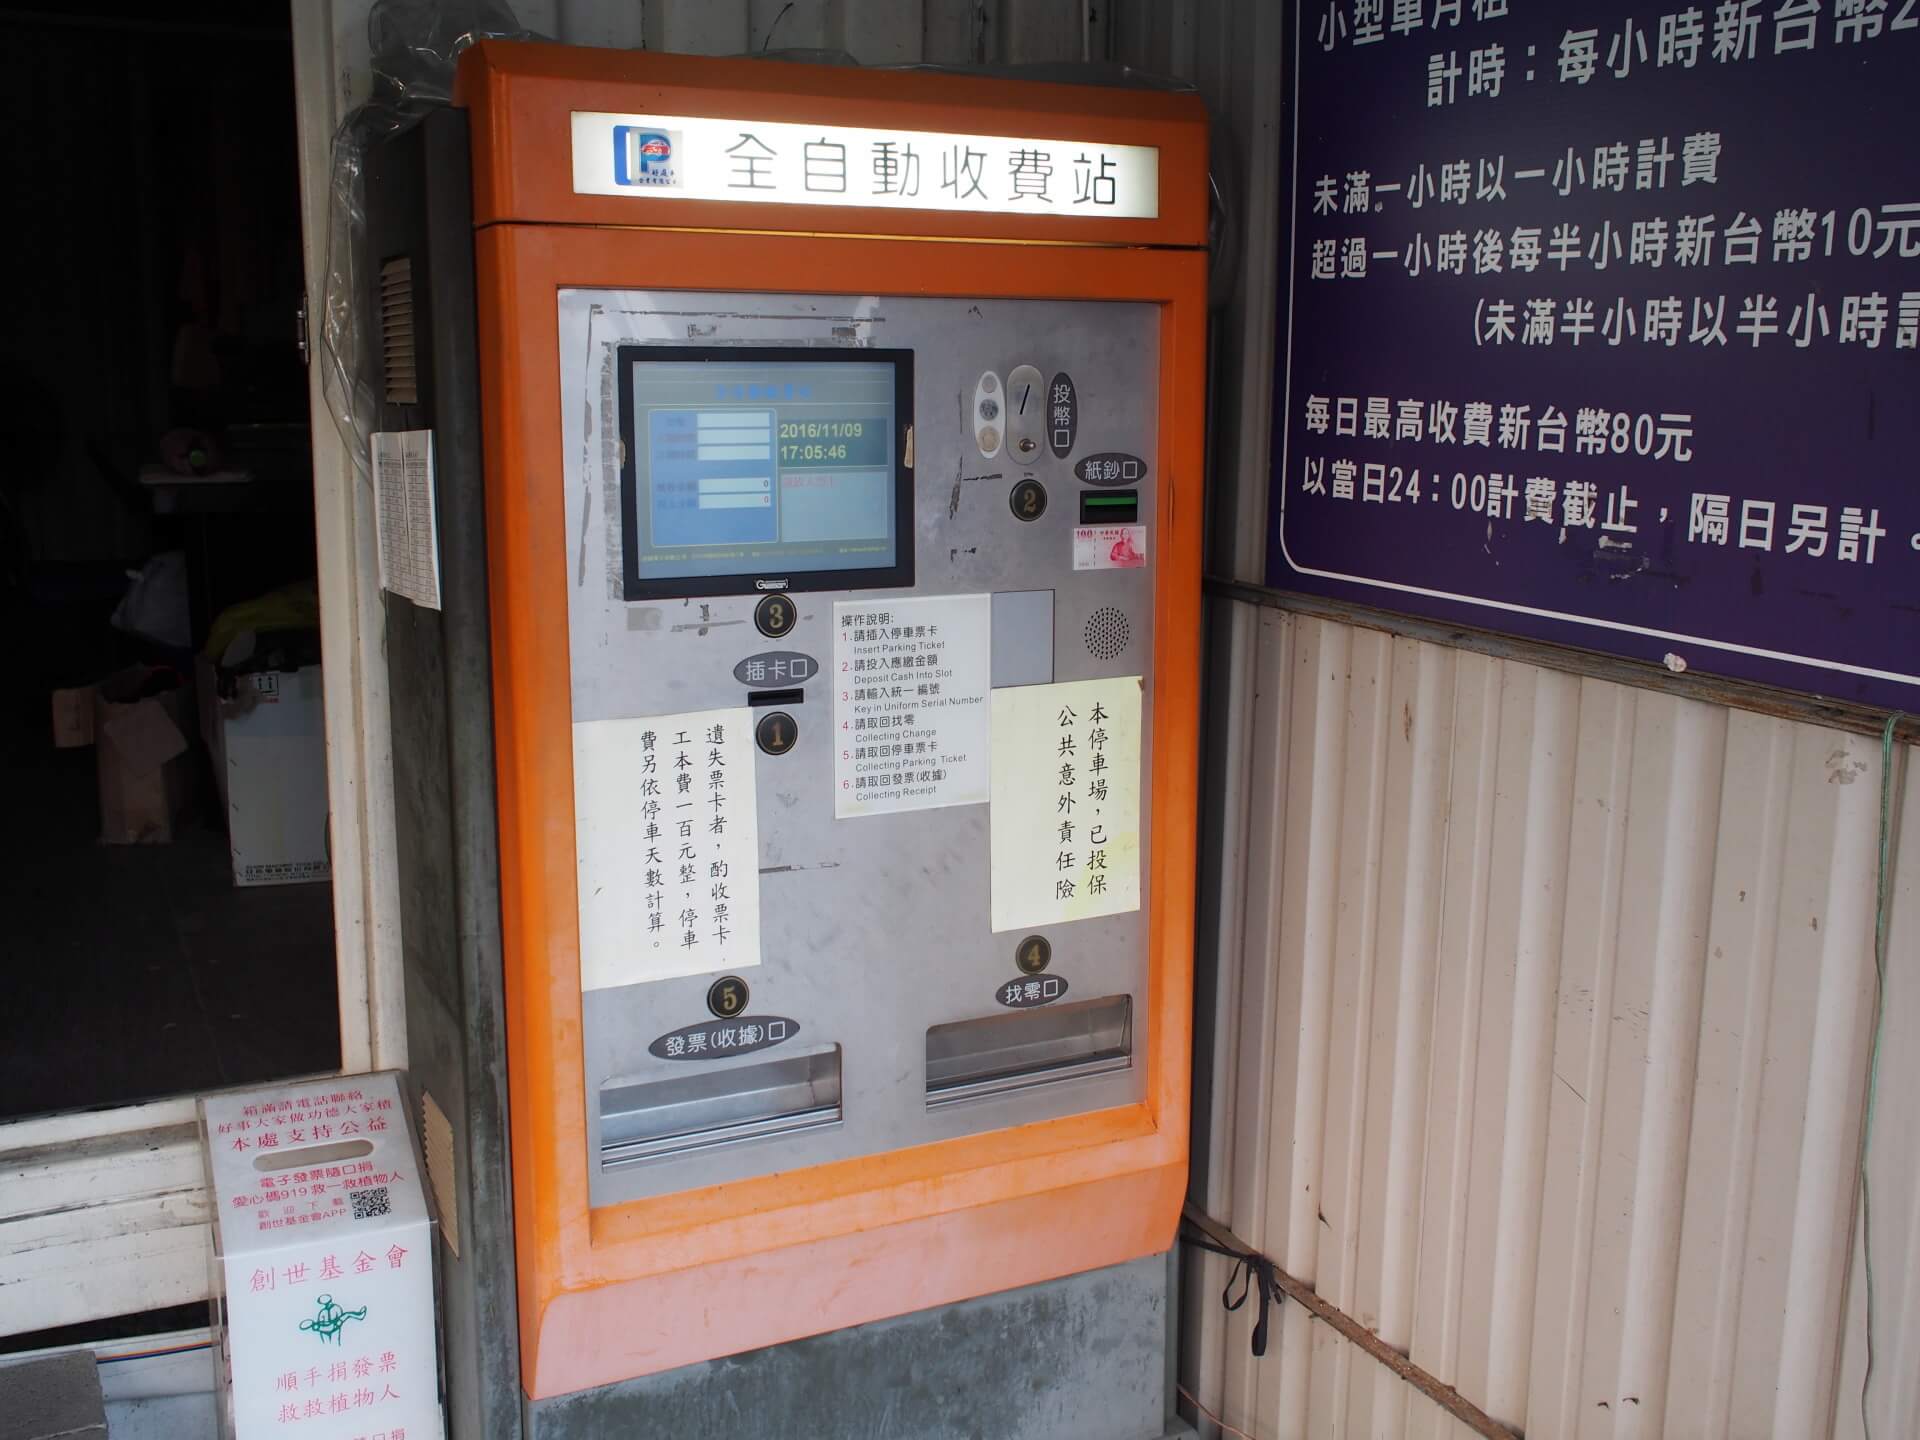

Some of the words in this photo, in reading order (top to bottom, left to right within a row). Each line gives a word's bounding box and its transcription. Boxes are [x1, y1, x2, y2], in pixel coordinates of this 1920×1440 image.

[725, 133, 1117, 205] 全自動收費站
[1313, 132, 1722, 216] 未滿一小時以一小時計費
[1311, 203, 1920, 280] 超過一小時後每半小時新台幣10元
[1053, 384, 1071, 448] 投幣口
[1305, 394, 1693, 462] 每日最高收費新台幣80元
[780, 423, 862, 439] 2016/11/09
[780, 444, 847, 460] 17:05:46
[1085, 460, 1138, 480] 紙鈔口
[1023, 489, 1036, 513] 2
[769, 604, 784, 629] 3
[841, 612, 894, 628] 操作說明:
[854, 645, 880, 654] Insert
[882, 642, 917, 653] Parking
[919, 640, 945, 650] Ticket
[746, 659, 807, 681] 插卡口
[854, 674, 889, 684] Deposit
[891, 671, 914, 682] Cash
[916, 671, 933, 680] Into
[935, 669, 953, 678] Slot
[854, 704, 872, 714] Key
[873, 703, 882, 712] in
[884, 701, 919, 711] Uniform
[921, 698, 947, 708] Serial
[949, 695, 984, 706] Number
[772, 721, 784, 746] 1
[855, 731, 900, 743] Collecting
[902, 728, 937, 738] Change
[855, 761, 900, 772] Collecting
[902, 757, 937, 768] Parking
[941, 754, 967, 764] Ticket
[856, 790, 901, 801] Collecting
[903, 785, 937, 796] Receipt
[1056, 705, 1077, 900] 公共意外責任險
[640, 730, 665, 948] 費另依停車天數計算。
[1027, 946, 1041, 966] 4
[723, 987, 738, 1010] 5
[1005, 979, 1059, 1004] 找零口
[665, 1021, 786, 1057] 發票(收據)口
[233, 1116, 388, 1151] 本處支持公益
[249, 1244, 408, 1293] 創世基金會
[275, 1351, 398, 1392] 順手捐發票
[277, 1383, 401, 1424] 救救植物人
